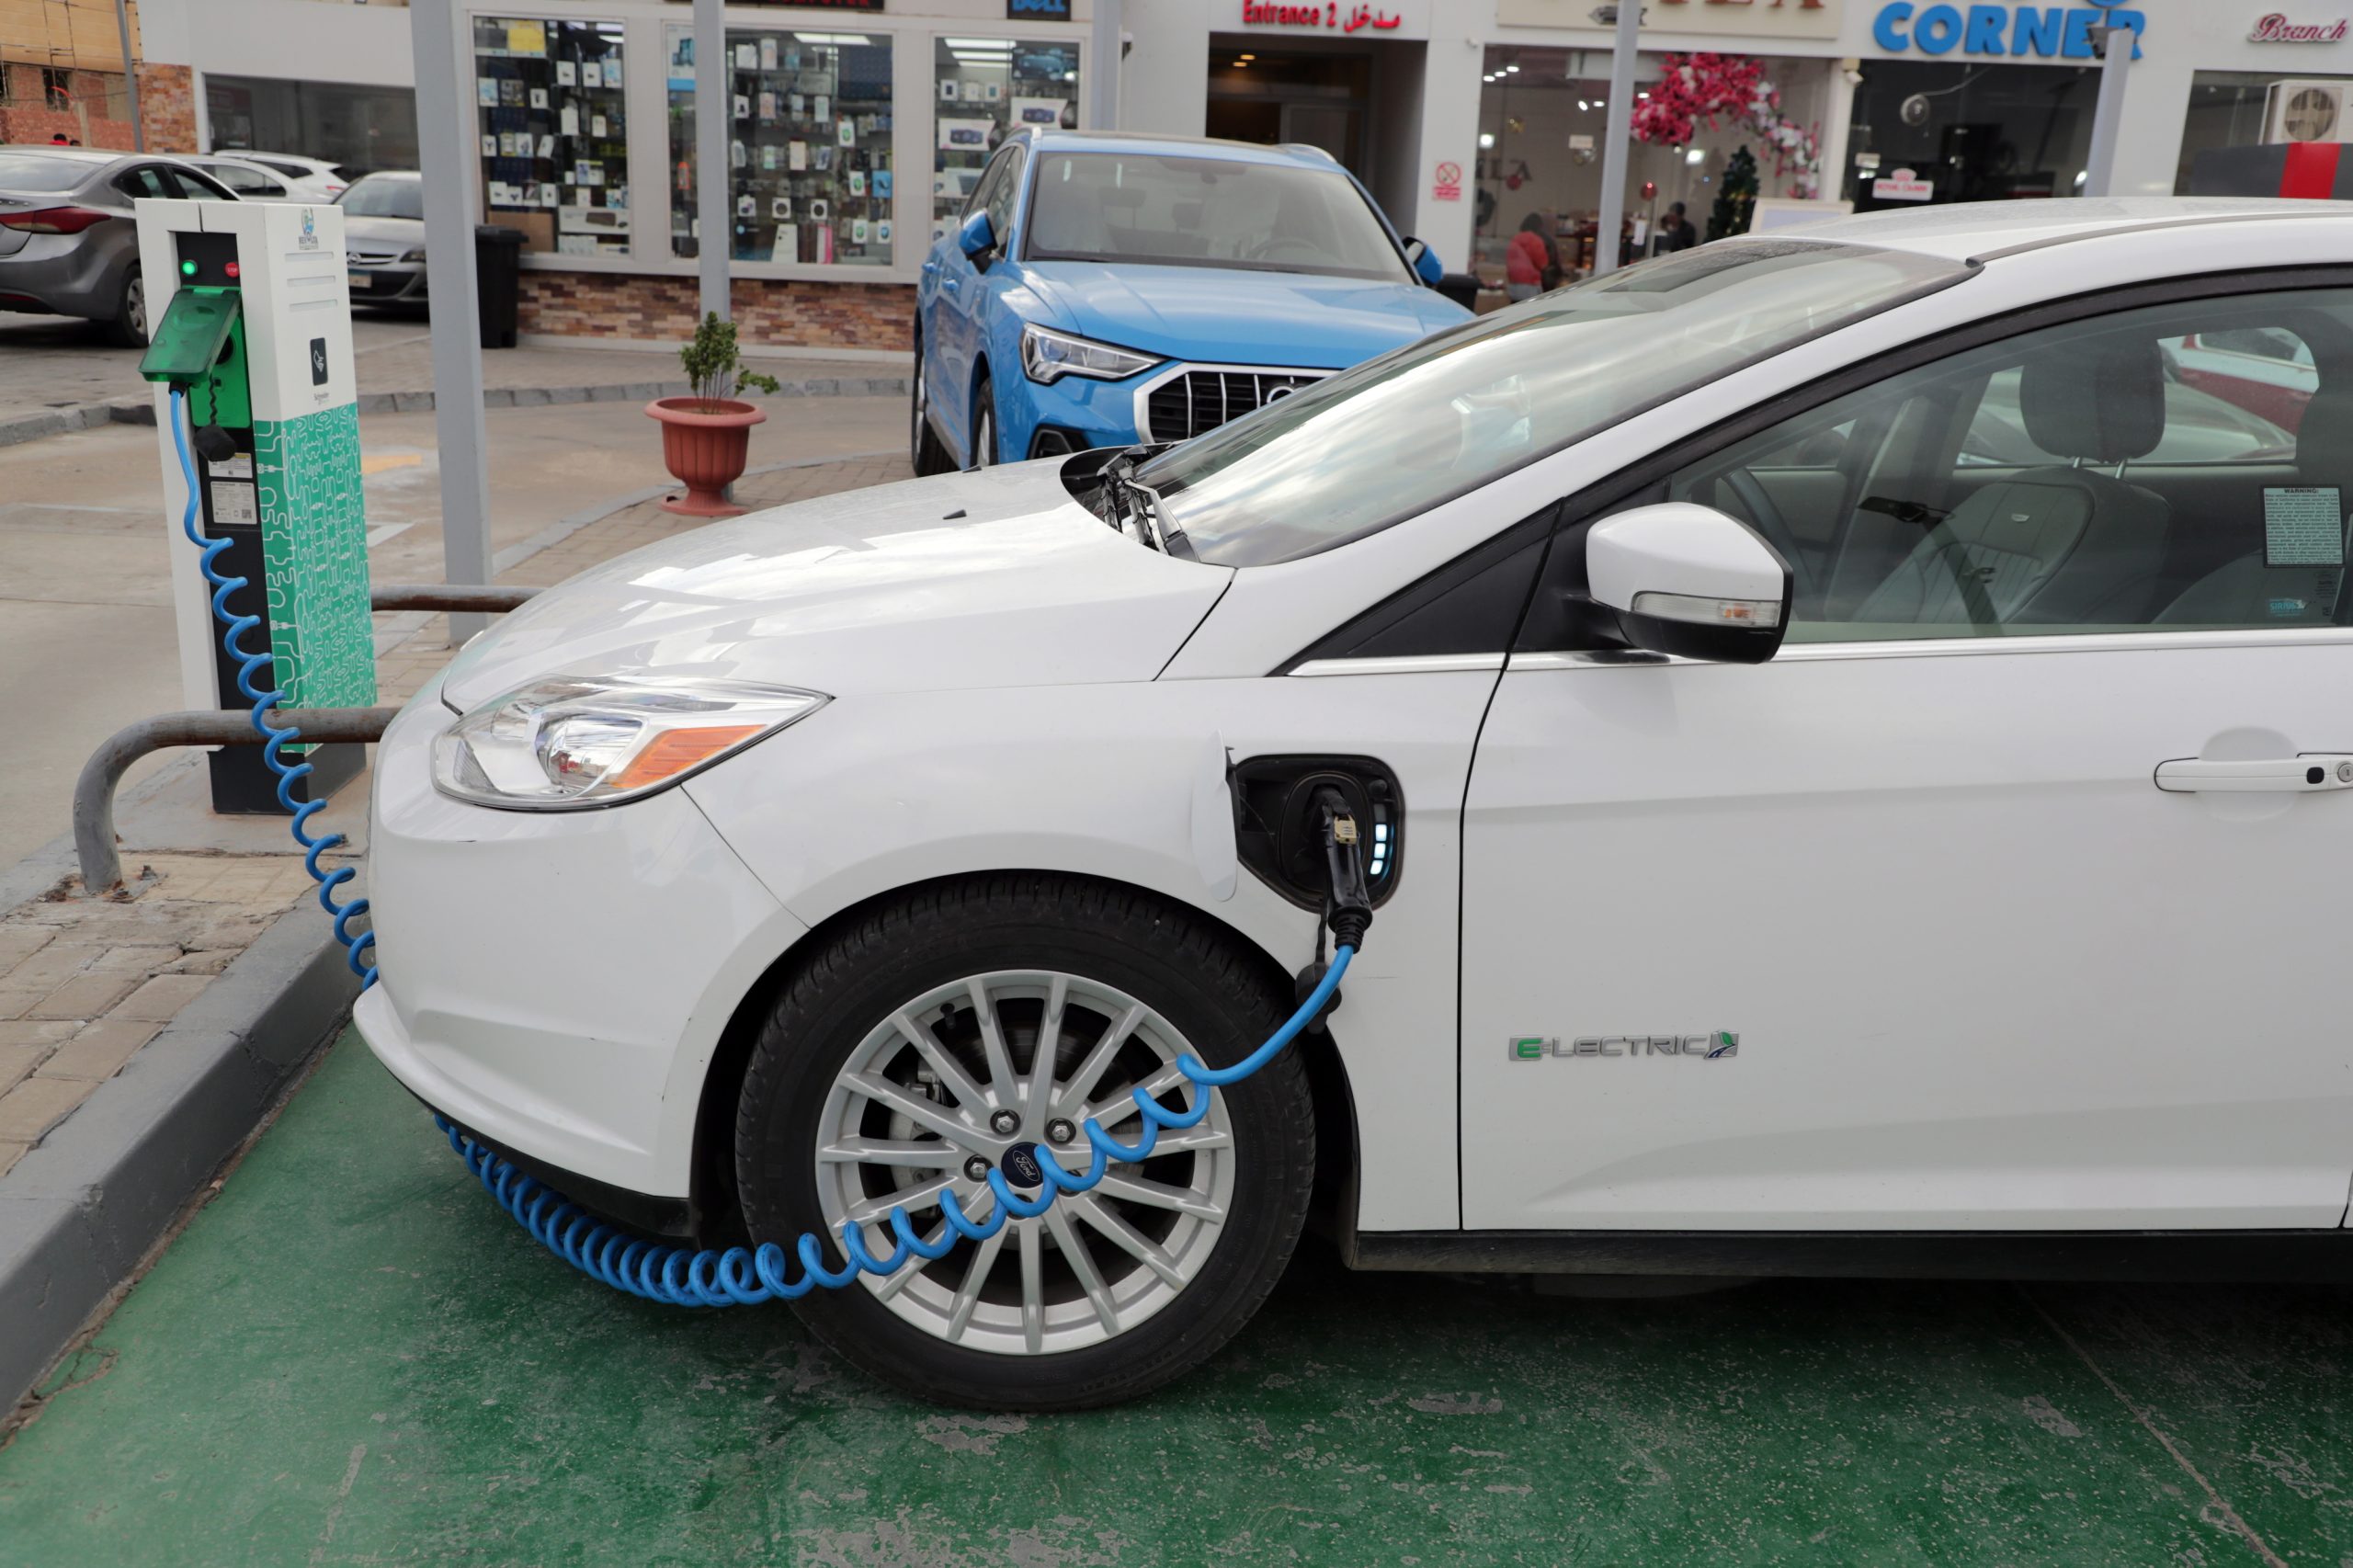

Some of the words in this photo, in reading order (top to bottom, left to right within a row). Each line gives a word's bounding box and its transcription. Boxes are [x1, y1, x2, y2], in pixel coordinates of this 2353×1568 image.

[1243, 0, 1320, 26] Entrance
[1326, 2, 1336, 28] 2
[1344, 5, 1401, 33] مدخل
[2248, 13, 2349, 43] Branch
[1873, 1, 2146, 60] CORNER
[1016, 1156, 1037, 1176] Ford
